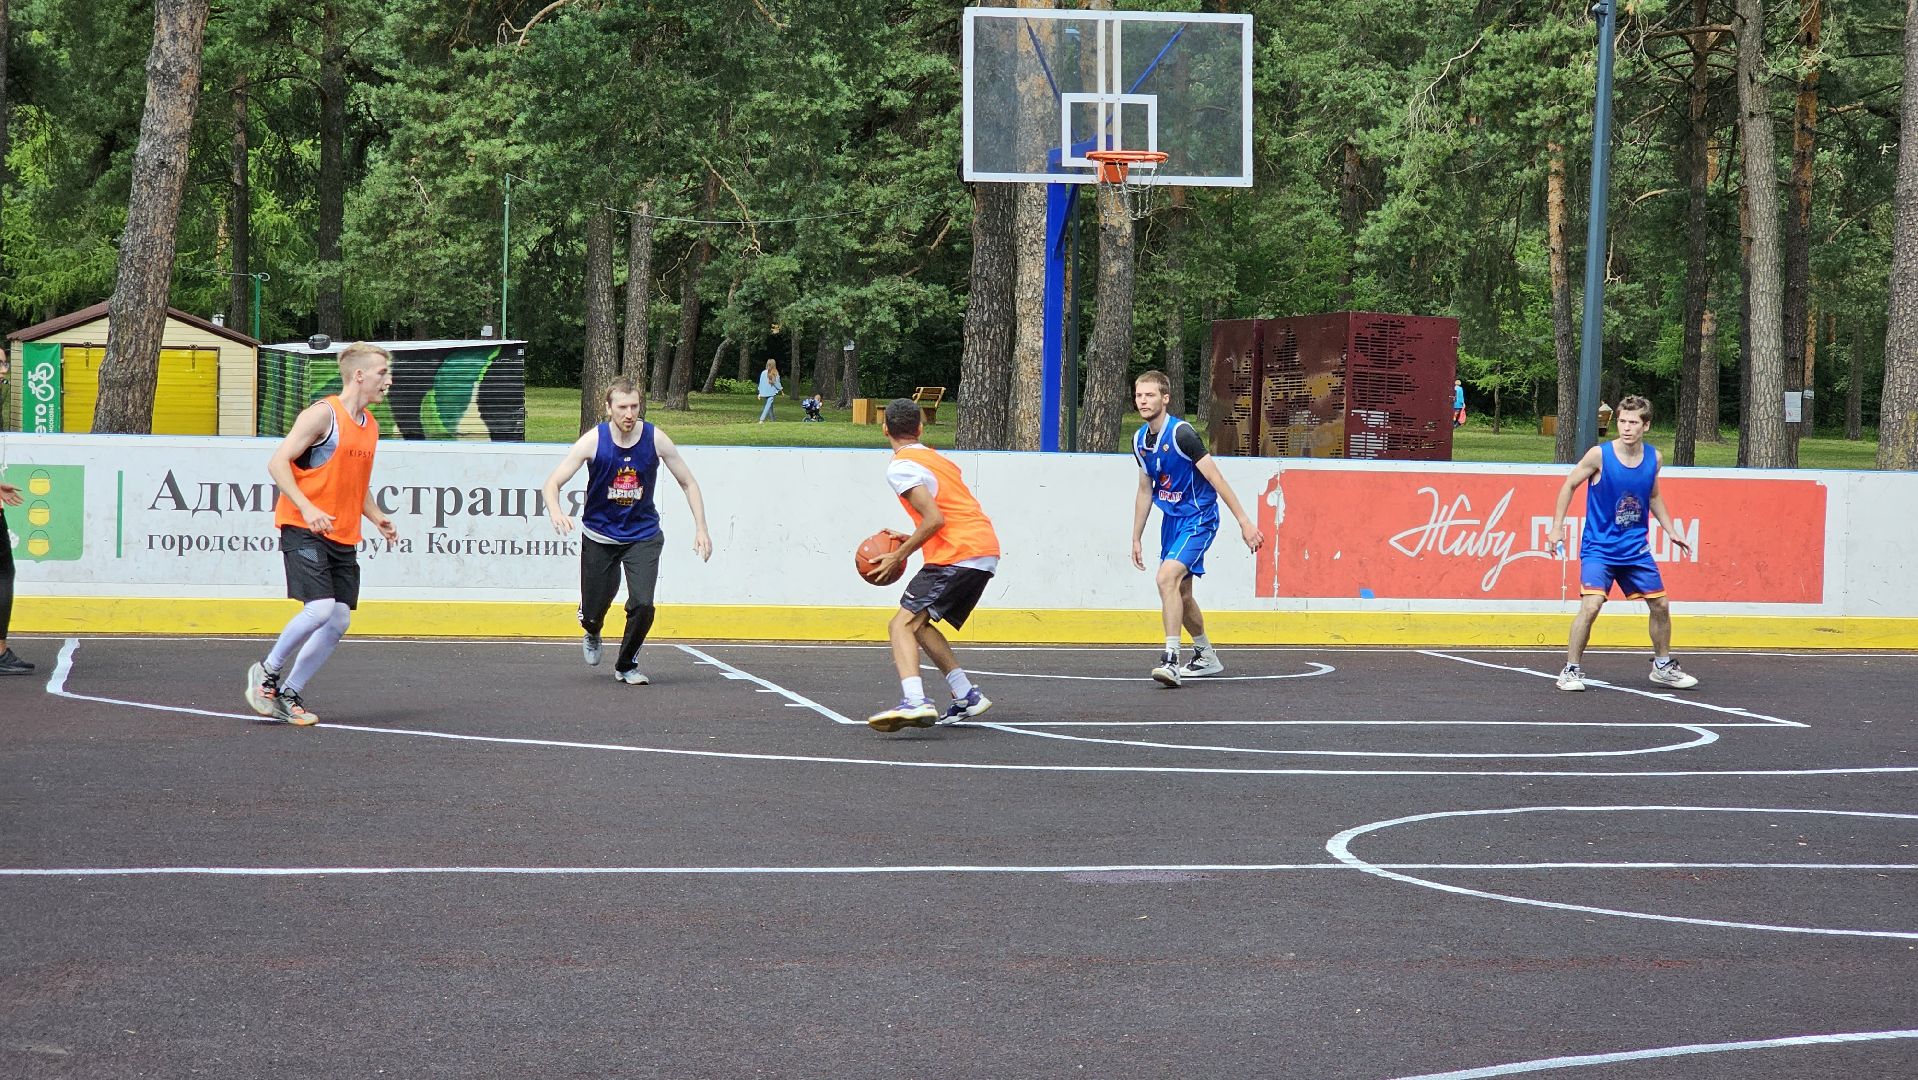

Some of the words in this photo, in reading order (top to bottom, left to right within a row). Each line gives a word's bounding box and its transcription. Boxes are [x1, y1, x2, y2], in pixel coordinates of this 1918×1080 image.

[35, 404, 47, 433] ето
[148, 468, 588, 528] Адмстрация
[607, 486, 643, 500] REIGN
[147, 533, 284, 557] городско
[427, 532, 582, 557] Котельник
